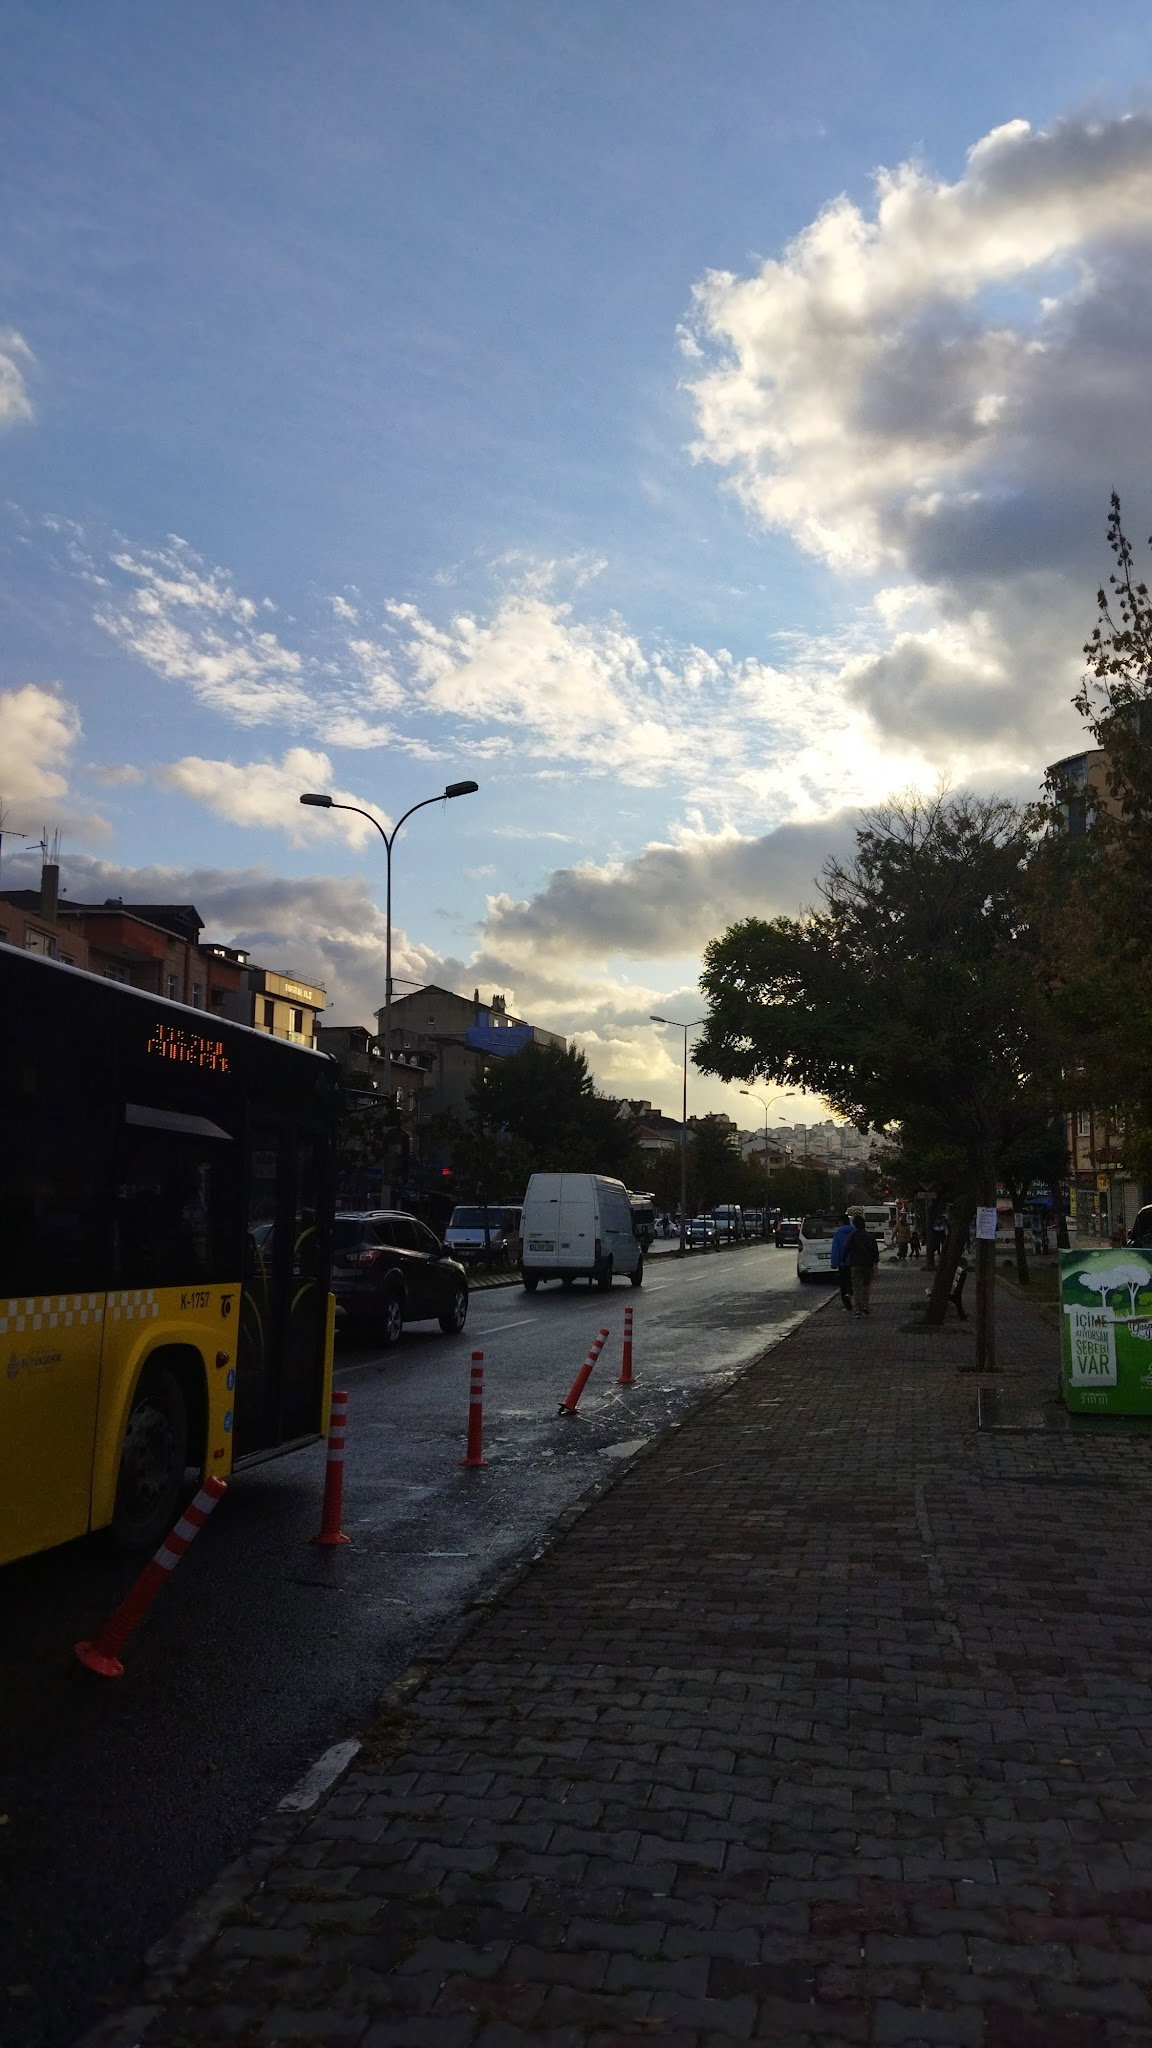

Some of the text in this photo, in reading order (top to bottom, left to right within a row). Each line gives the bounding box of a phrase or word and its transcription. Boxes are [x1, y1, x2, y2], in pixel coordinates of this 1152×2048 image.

[181, 1291, 210, 1310] K-1757
[1075, 1311, 1108, 1330] İÇİME
[1076, 1340, 1109, 1355] SEBEBİ
[1077, 1354, 1110, 1375] VAR
